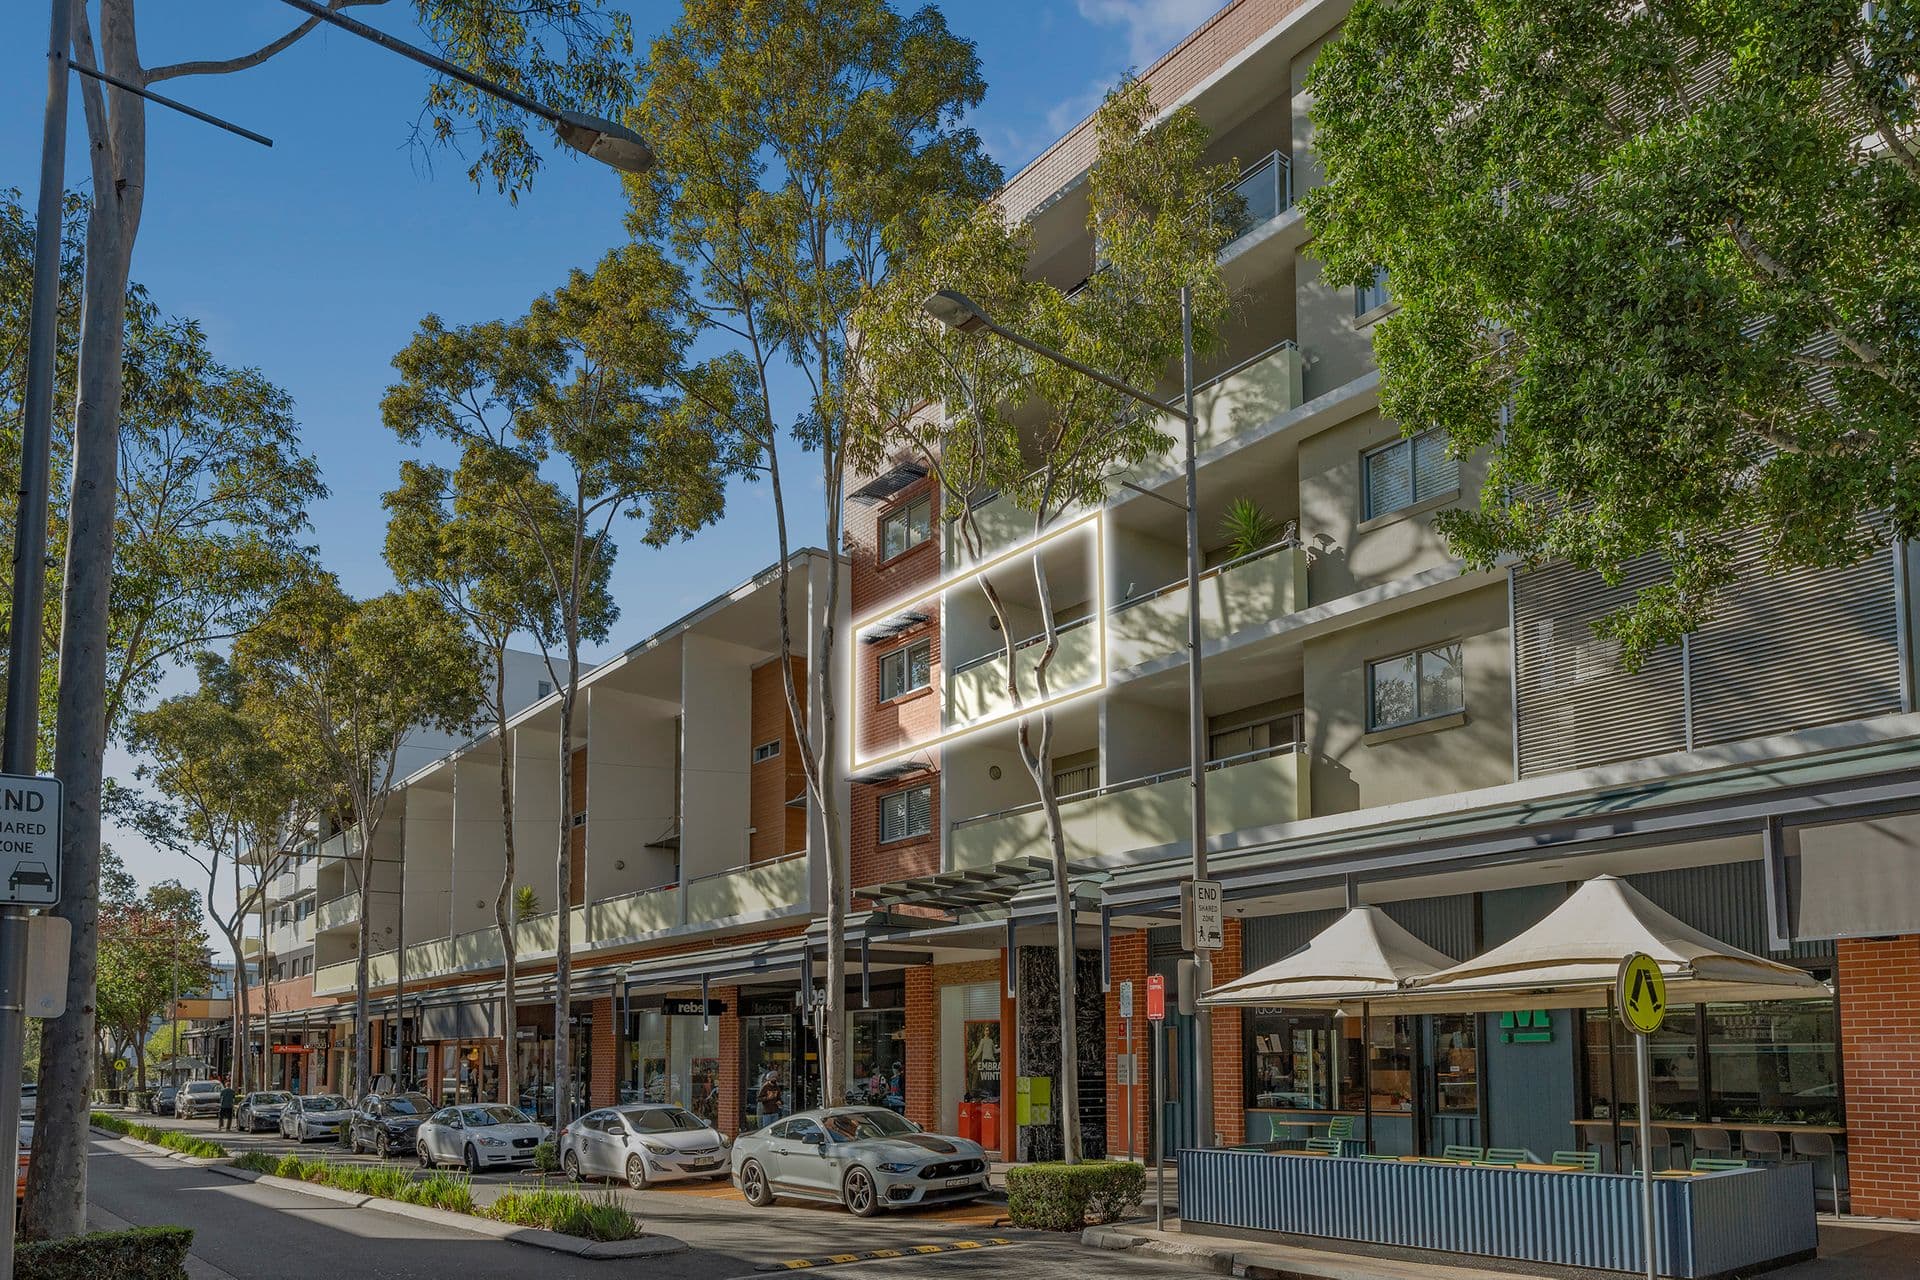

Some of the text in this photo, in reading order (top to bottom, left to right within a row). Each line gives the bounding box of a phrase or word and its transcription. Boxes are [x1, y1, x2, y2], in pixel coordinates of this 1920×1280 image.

[0, 788, 44, 812] ND
[0, 821, 46, 835] ARED
[1198, 887, 1217, 900] END
[1198, 904, 1218, 913] SHARED
[1202, 914, 1215, 923] ZONE
[678, 1001, 705, 1013] rebe
[980, 1071, 1002, 1081] WINT
